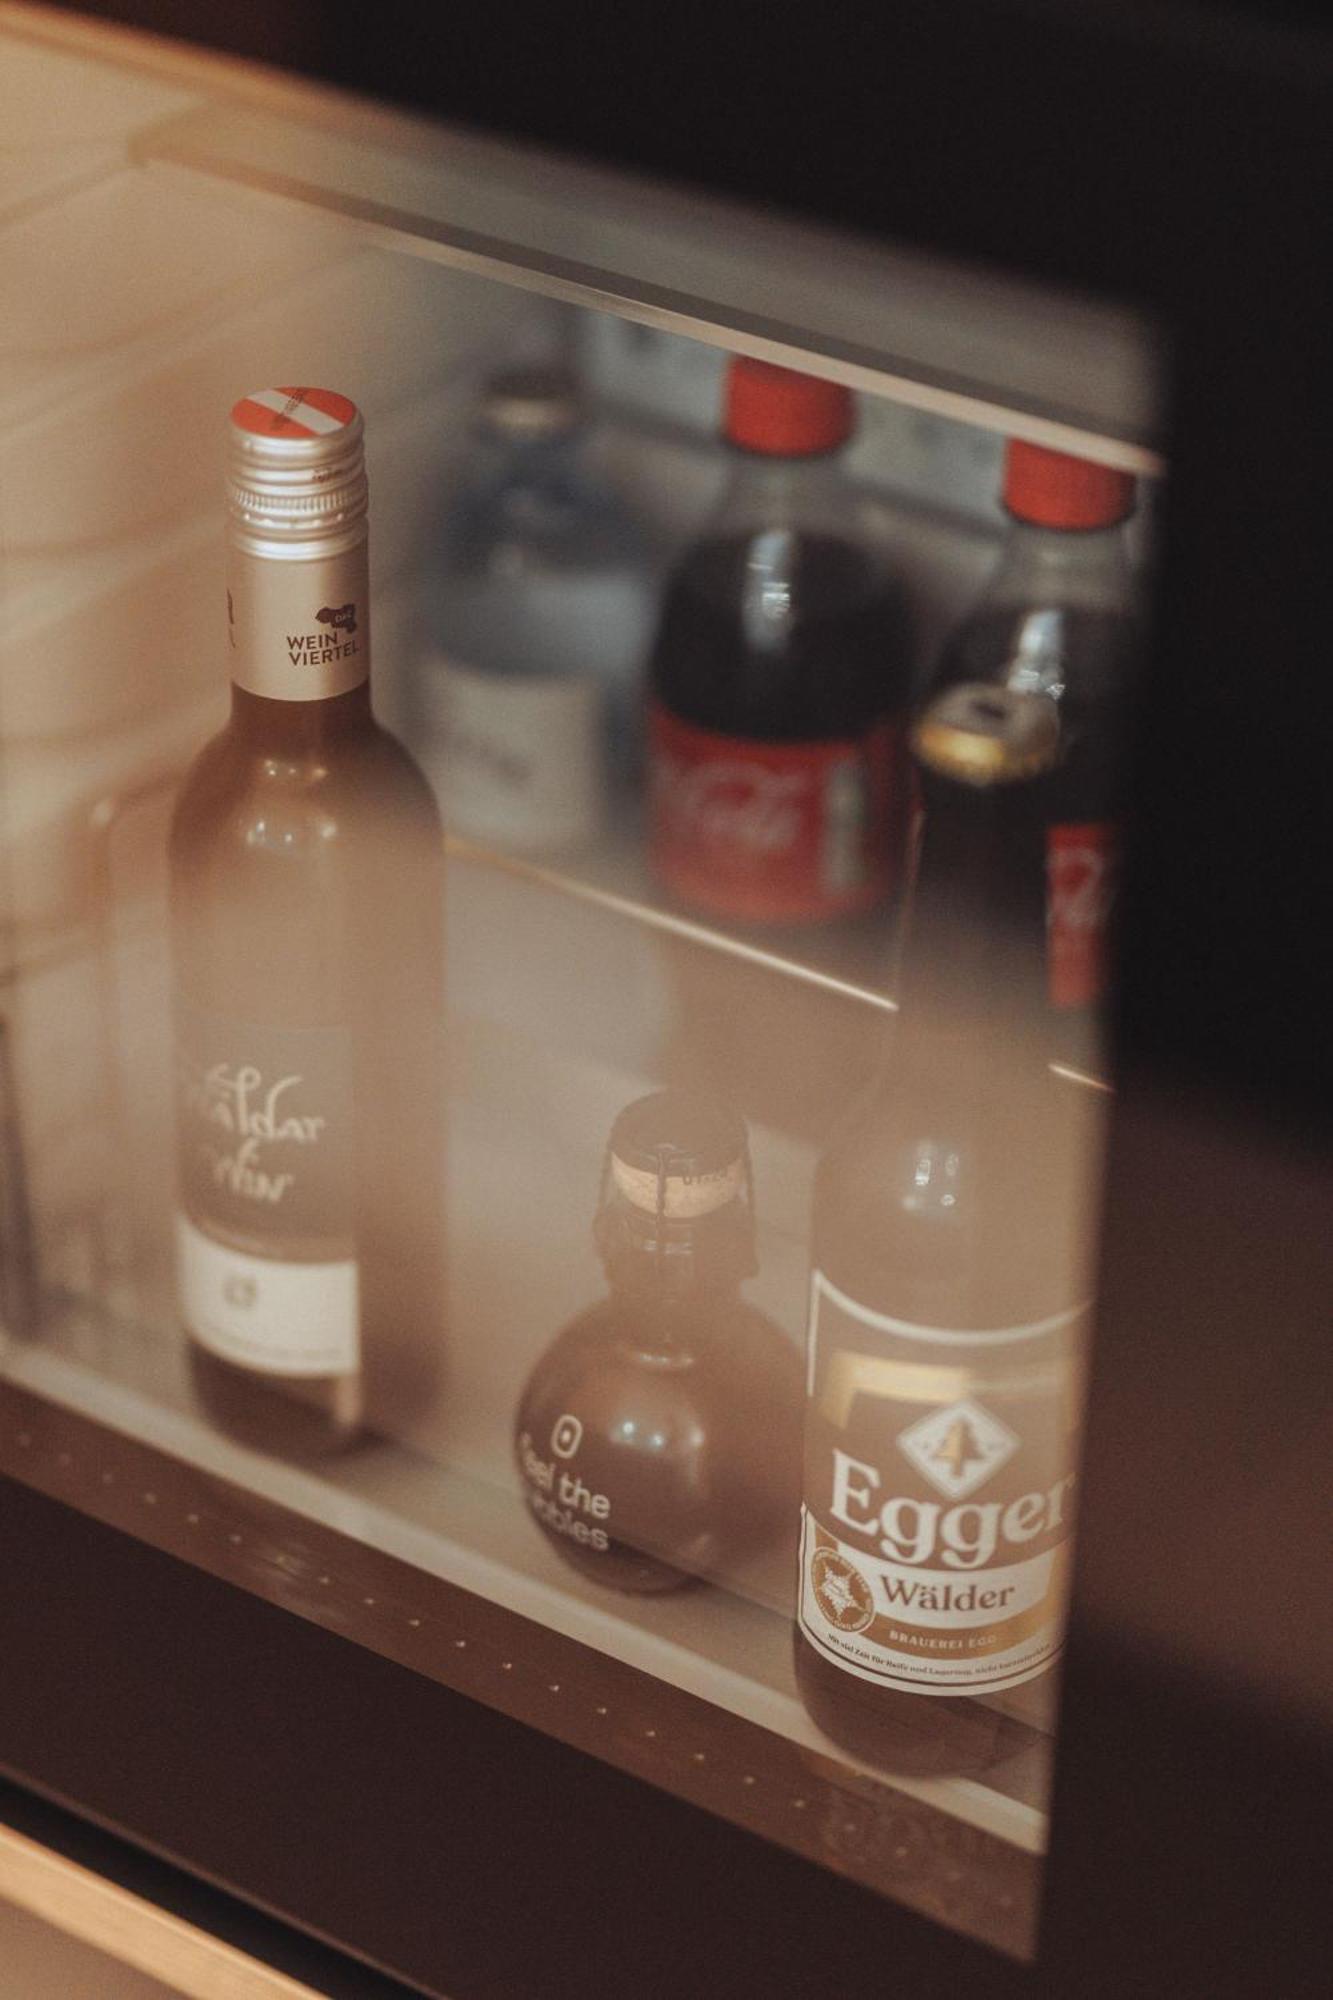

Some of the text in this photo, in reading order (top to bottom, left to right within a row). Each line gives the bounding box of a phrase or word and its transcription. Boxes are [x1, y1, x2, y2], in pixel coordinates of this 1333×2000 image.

[286, 631, 338, 650] WEIN
[288, 640, 360, 666] VIERTEL
[559, 1472, 611, 1519] the
[830, 1446, 1075, 1569] Egger
[880, 1574, 1015, 1612] Wälder
[889, 1629, 963, 1650] BRAUEREI
